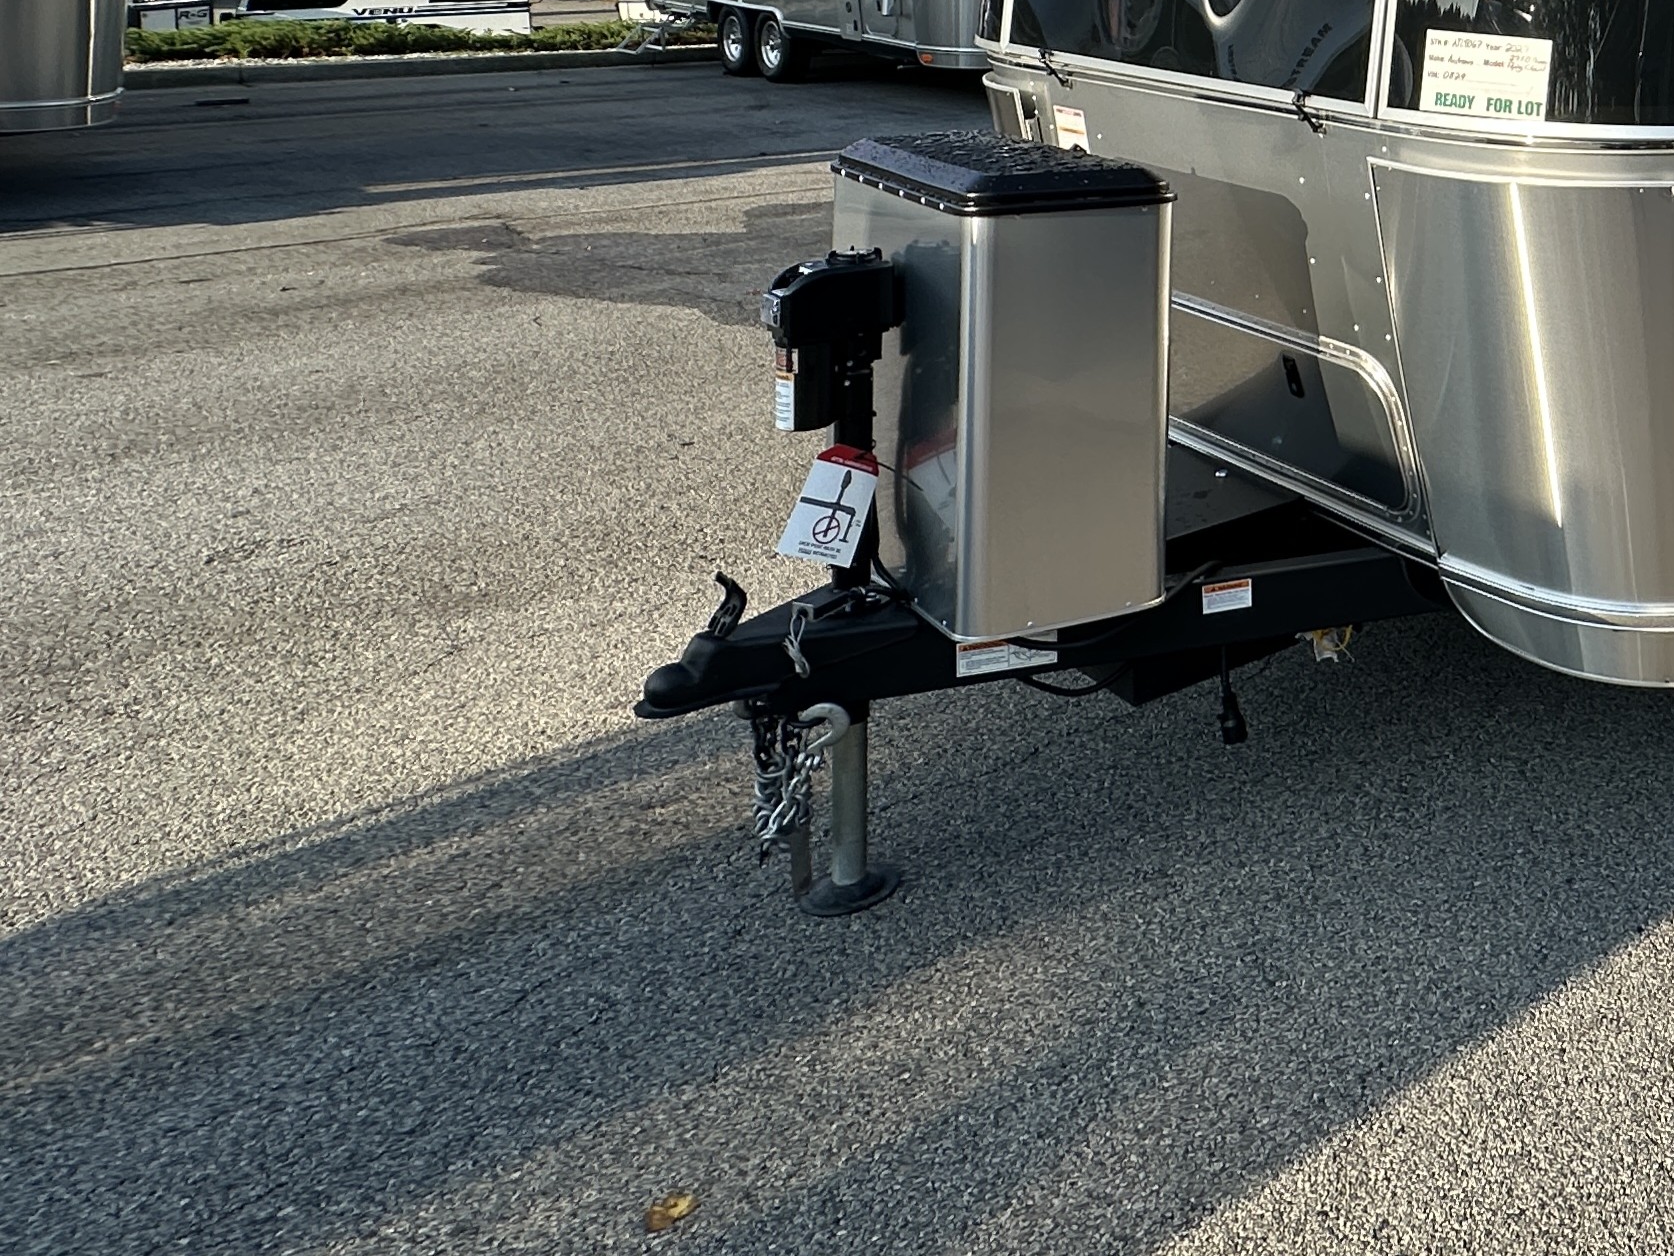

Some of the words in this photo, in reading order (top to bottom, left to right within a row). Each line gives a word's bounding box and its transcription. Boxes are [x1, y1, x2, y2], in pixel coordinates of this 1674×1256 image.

[1435, 92, 1475, 109] READY
[1486, 97, 1513, 114] FOR
[1517, 100, 1543, 116] LOT
